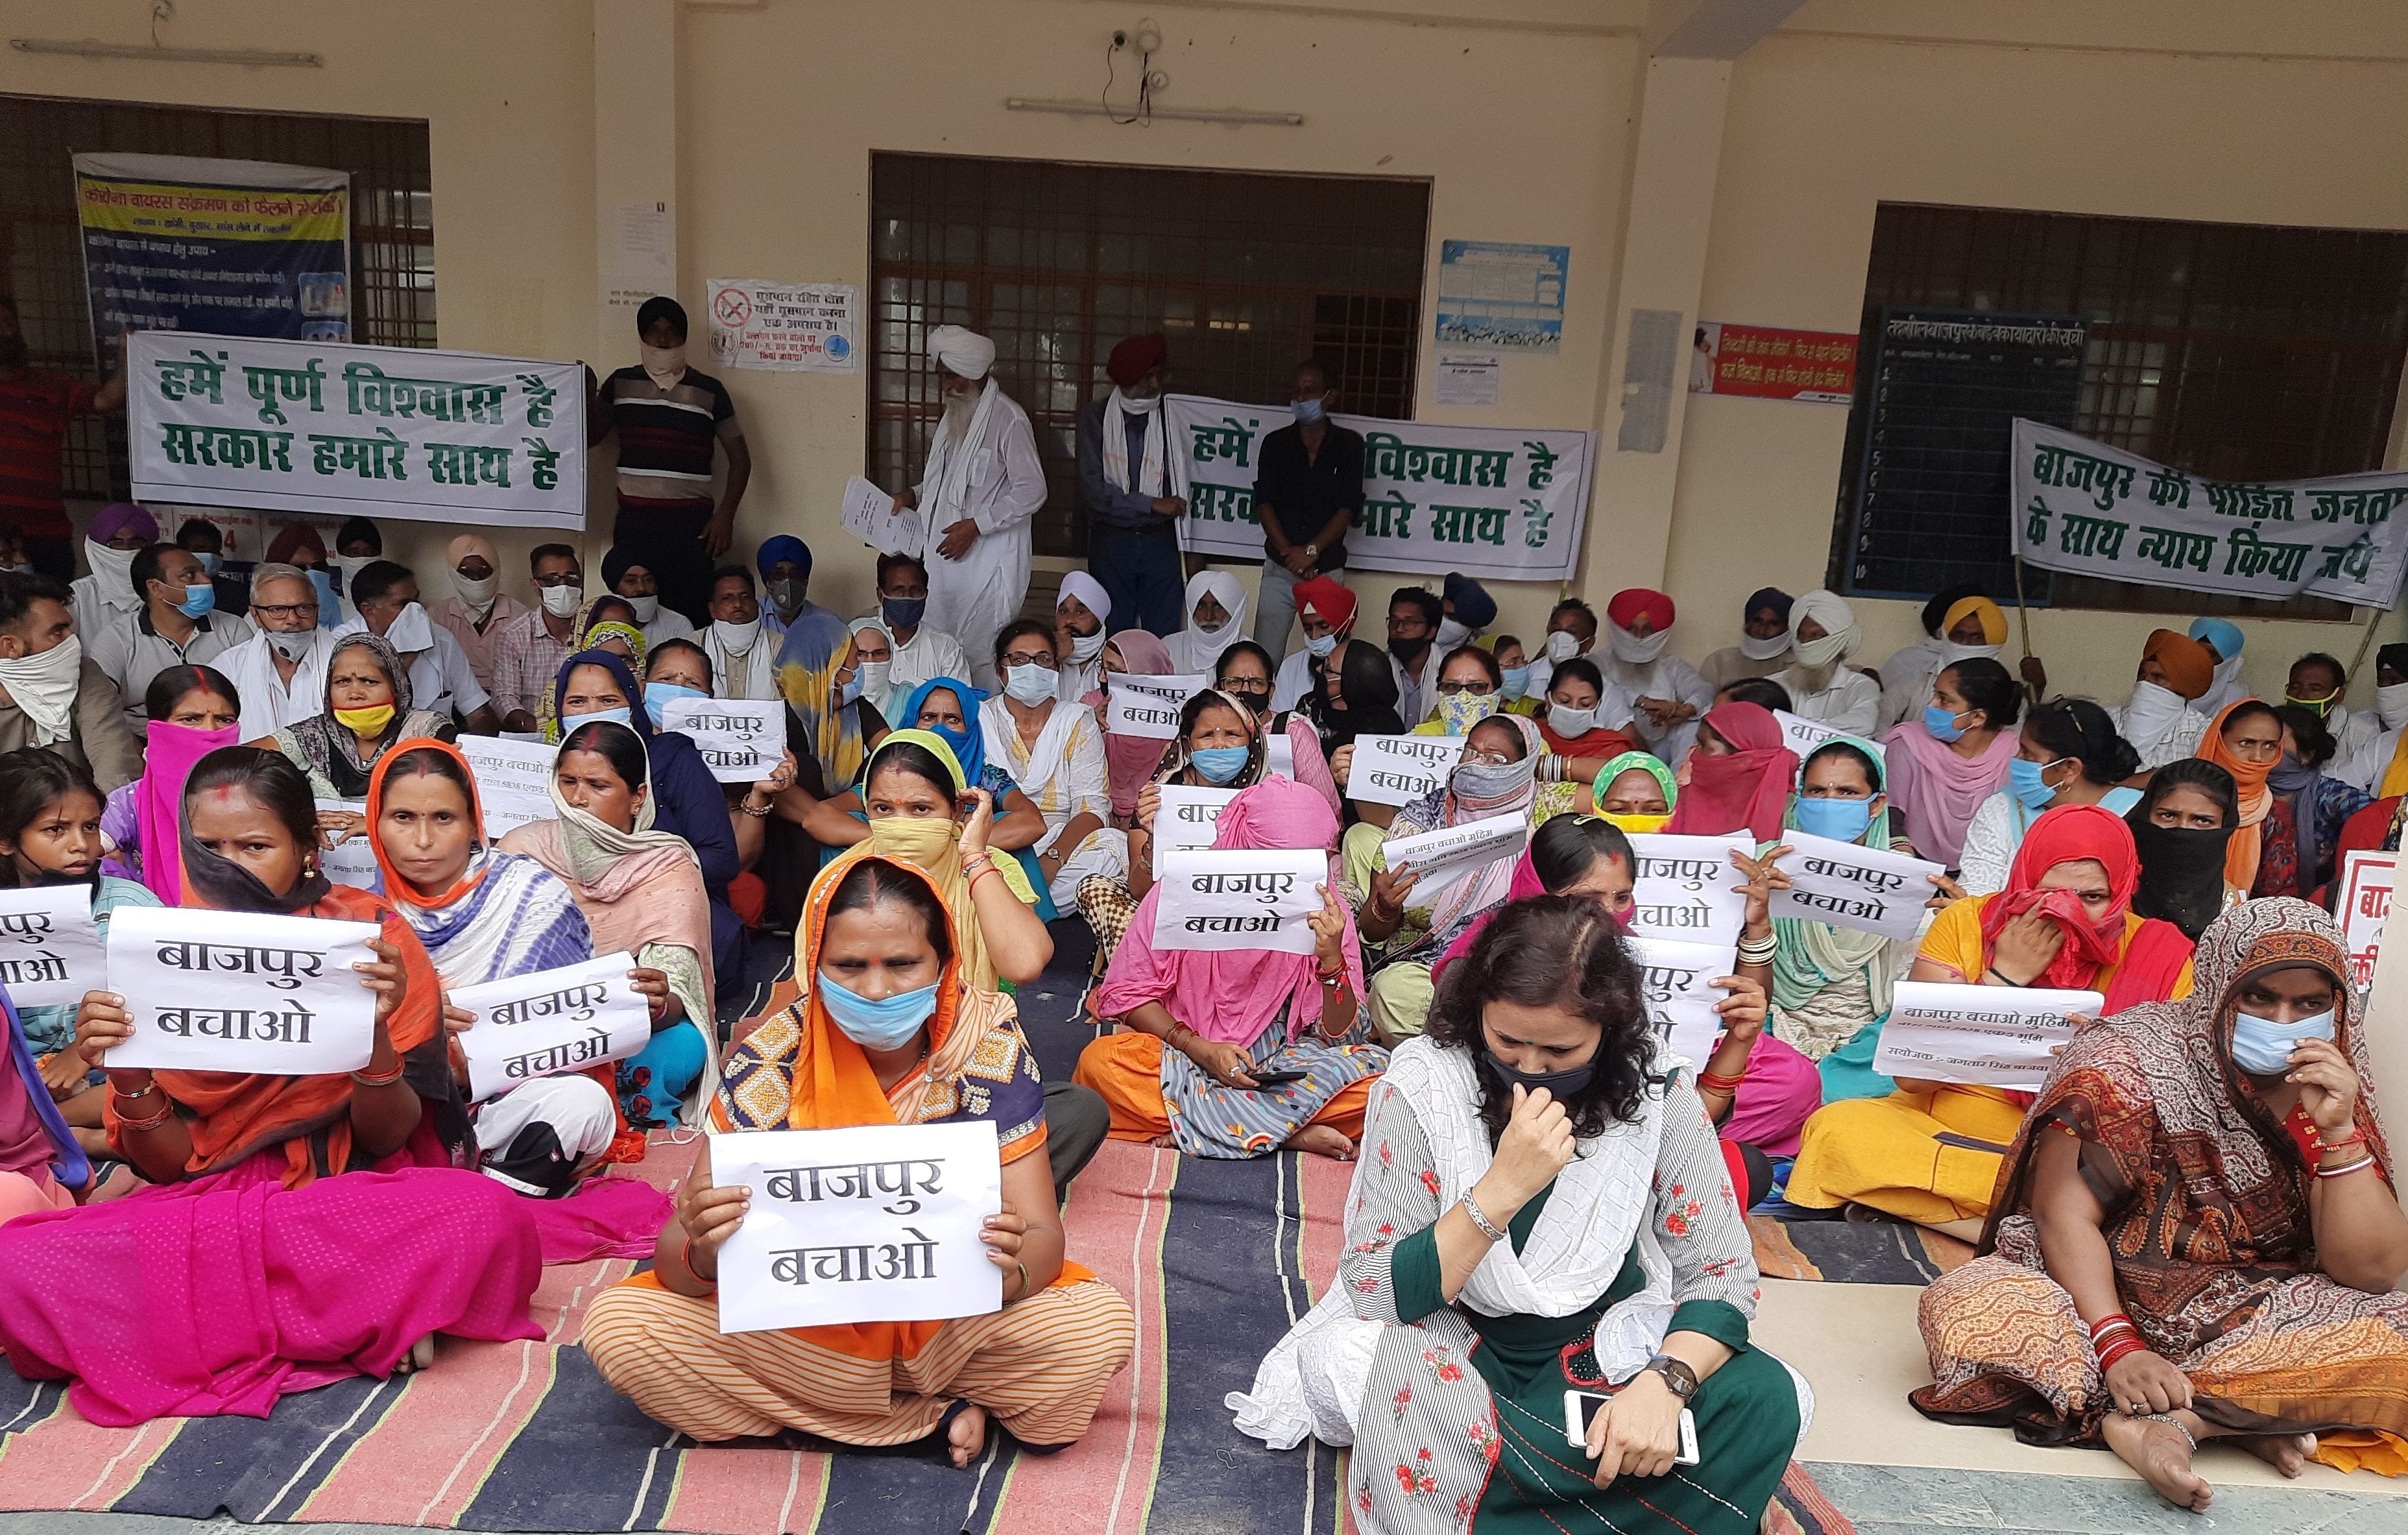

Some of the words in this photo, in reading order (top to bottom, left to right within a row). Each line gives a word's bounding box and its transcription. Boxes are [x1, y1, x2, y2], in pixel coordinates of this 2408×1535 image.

[130, 194, 173, 210] वायरस
[177, 193, 227, 213] संक्रमण
[232, 194, 251, 213] को
[256, 194, 293, 217] फैलने
[764, 318, 782, 327] एक
[787, 319, 822, 330] अपराध
[818, 308, 847, 318] करना
[1882, 367, 1889, 380] 1
[155, 350, 229, 405] हमें
[242, 358, 326, 426] पूर्ण
[341, 361, 507, 426] विश्वास
[515, 374, 557, 428] है
[156, 422, 295, 472] सरकार
[307, 427, 409, 481] हमारे
[424, 442, 514, 488] साथ
[521, 437, 561, 490] है
[1190, 417, 1260, 468] हमें
[1364, 431, 1513, 489] विश्वास
[1523, 441, 1559, 490] है
[1873, 451, 1880, 466] 5
[1870, 471, 1878, 487] 6
[2034, 442, 2136, 512] बाजपुर
[1867, 492, 1875, 505] 7
[1190, 481, 1260, 526] सरक
[1363, 490, 1417, 538] मारे
[1429, 503, 1511, 547] साथ
[1520, 498, 1554, 549] है
[1862, 511, 1872, 528] 8
[2025, 495, 2053, 546] के
[2060, 513, 2130, 561] साथ
[2137, 525, 2218, 572] न्याय
[2222, 527, 2314, 583] किया
[1126, 683, 1188, 704] बाजपुर
[684, 714, 765, 741] बाजपुर
[1123, 706, 1183, 727] बचाओ
[1790, 721, 1838, 743] बाज
[466, 755, 504, 771] ाजपुर
[506, 761, 544, 774] बचाओ
[704, 745, 762, 766] चाओ
[1376, 738, 1451, 768] बाजपुर
[502, 780, 521, 790] 5838
[1370, 769, 1441, 795] बचाओ
[1177, 804, 1225, 823] बाज
[1404, 842, 1436, 855] बाजपुर
[1437, 834, 1467, 847] बचाओ
[1467, 829, 1493, 843] मुहिम
[1804, 856, 1910, 893] बाजपुर
[1192, 872, 1297, 904] बाजपुर
[1792, 888, 1888, 922] बचाओ
[0, 912, 55, 944] पुर
[1185, 910, 1285, 933] बचाओ
[155, 939, 328, 991] बाजपुर
[1637, 965, 1700, 1003] पुर
[489, 981, 610, 1026] बाजपुर
[155, 998, 317, 1043] बचाओ
[1904, 1008, 1964, 1023] बाजपुर
[1966, 1010, 2024, 1025] बचाओ
[2025, 1012, 2071, 1030] मुहिम
[503, 1026, 612, 1079] बचाओ
[1946, 1056, 1988, 1067] जगतार
[1988, 1059, 2012, 1070] सिंह
[763, 1158, 946, 1215] बाजपुर
[769, 1227, 940, 1285] बचाओ
